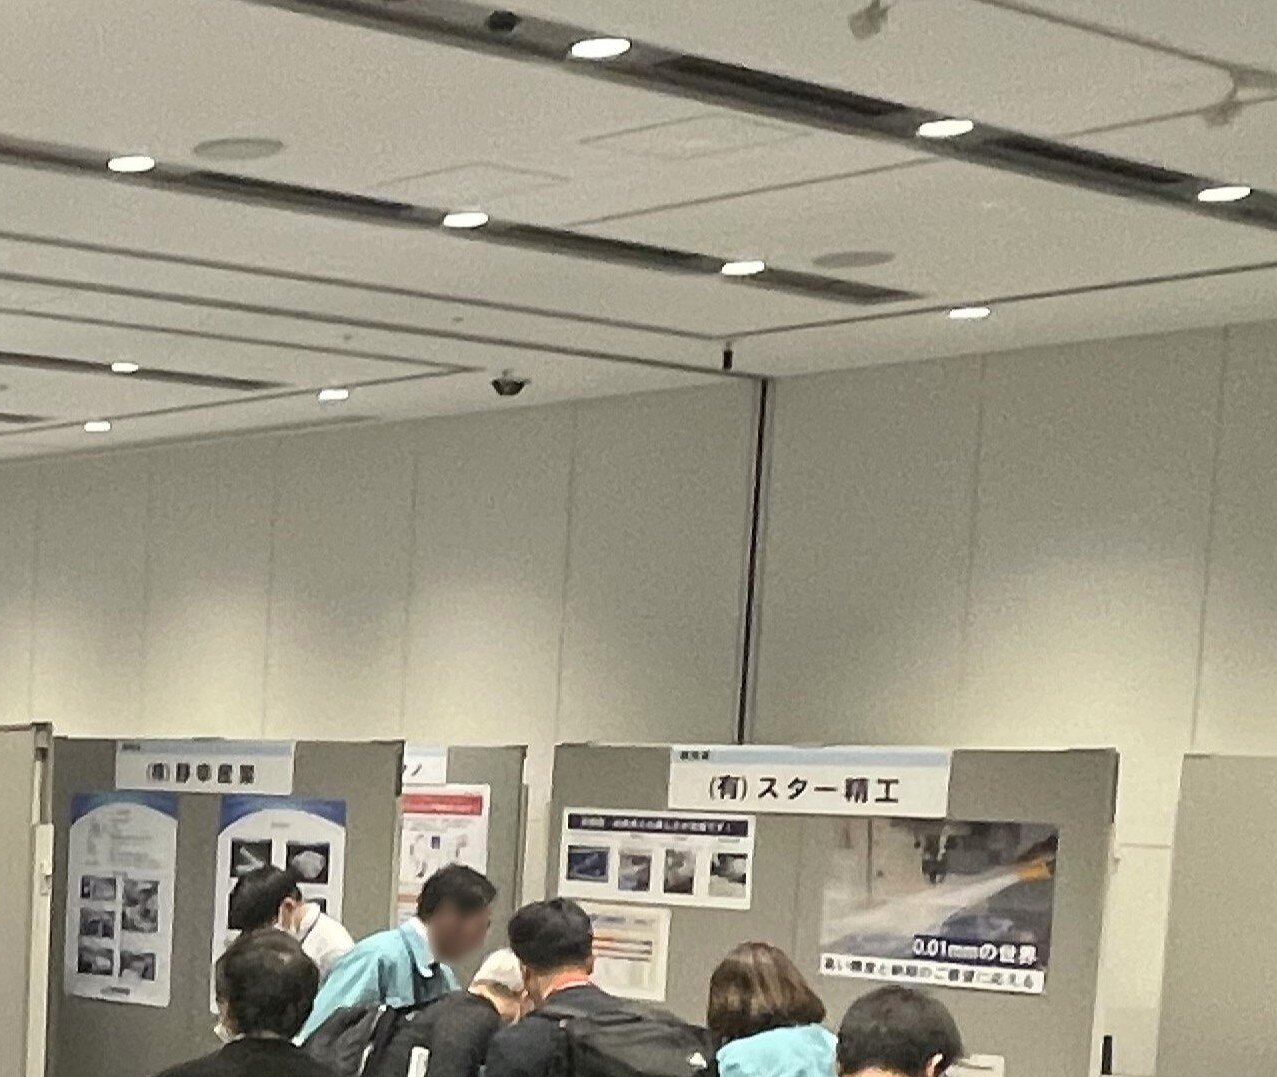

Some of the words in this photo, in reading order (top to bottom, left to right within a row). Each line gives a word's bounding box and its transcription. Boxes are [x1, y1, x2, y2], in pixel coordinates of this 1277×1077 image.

[757, 776, 900, 804] スター精工
